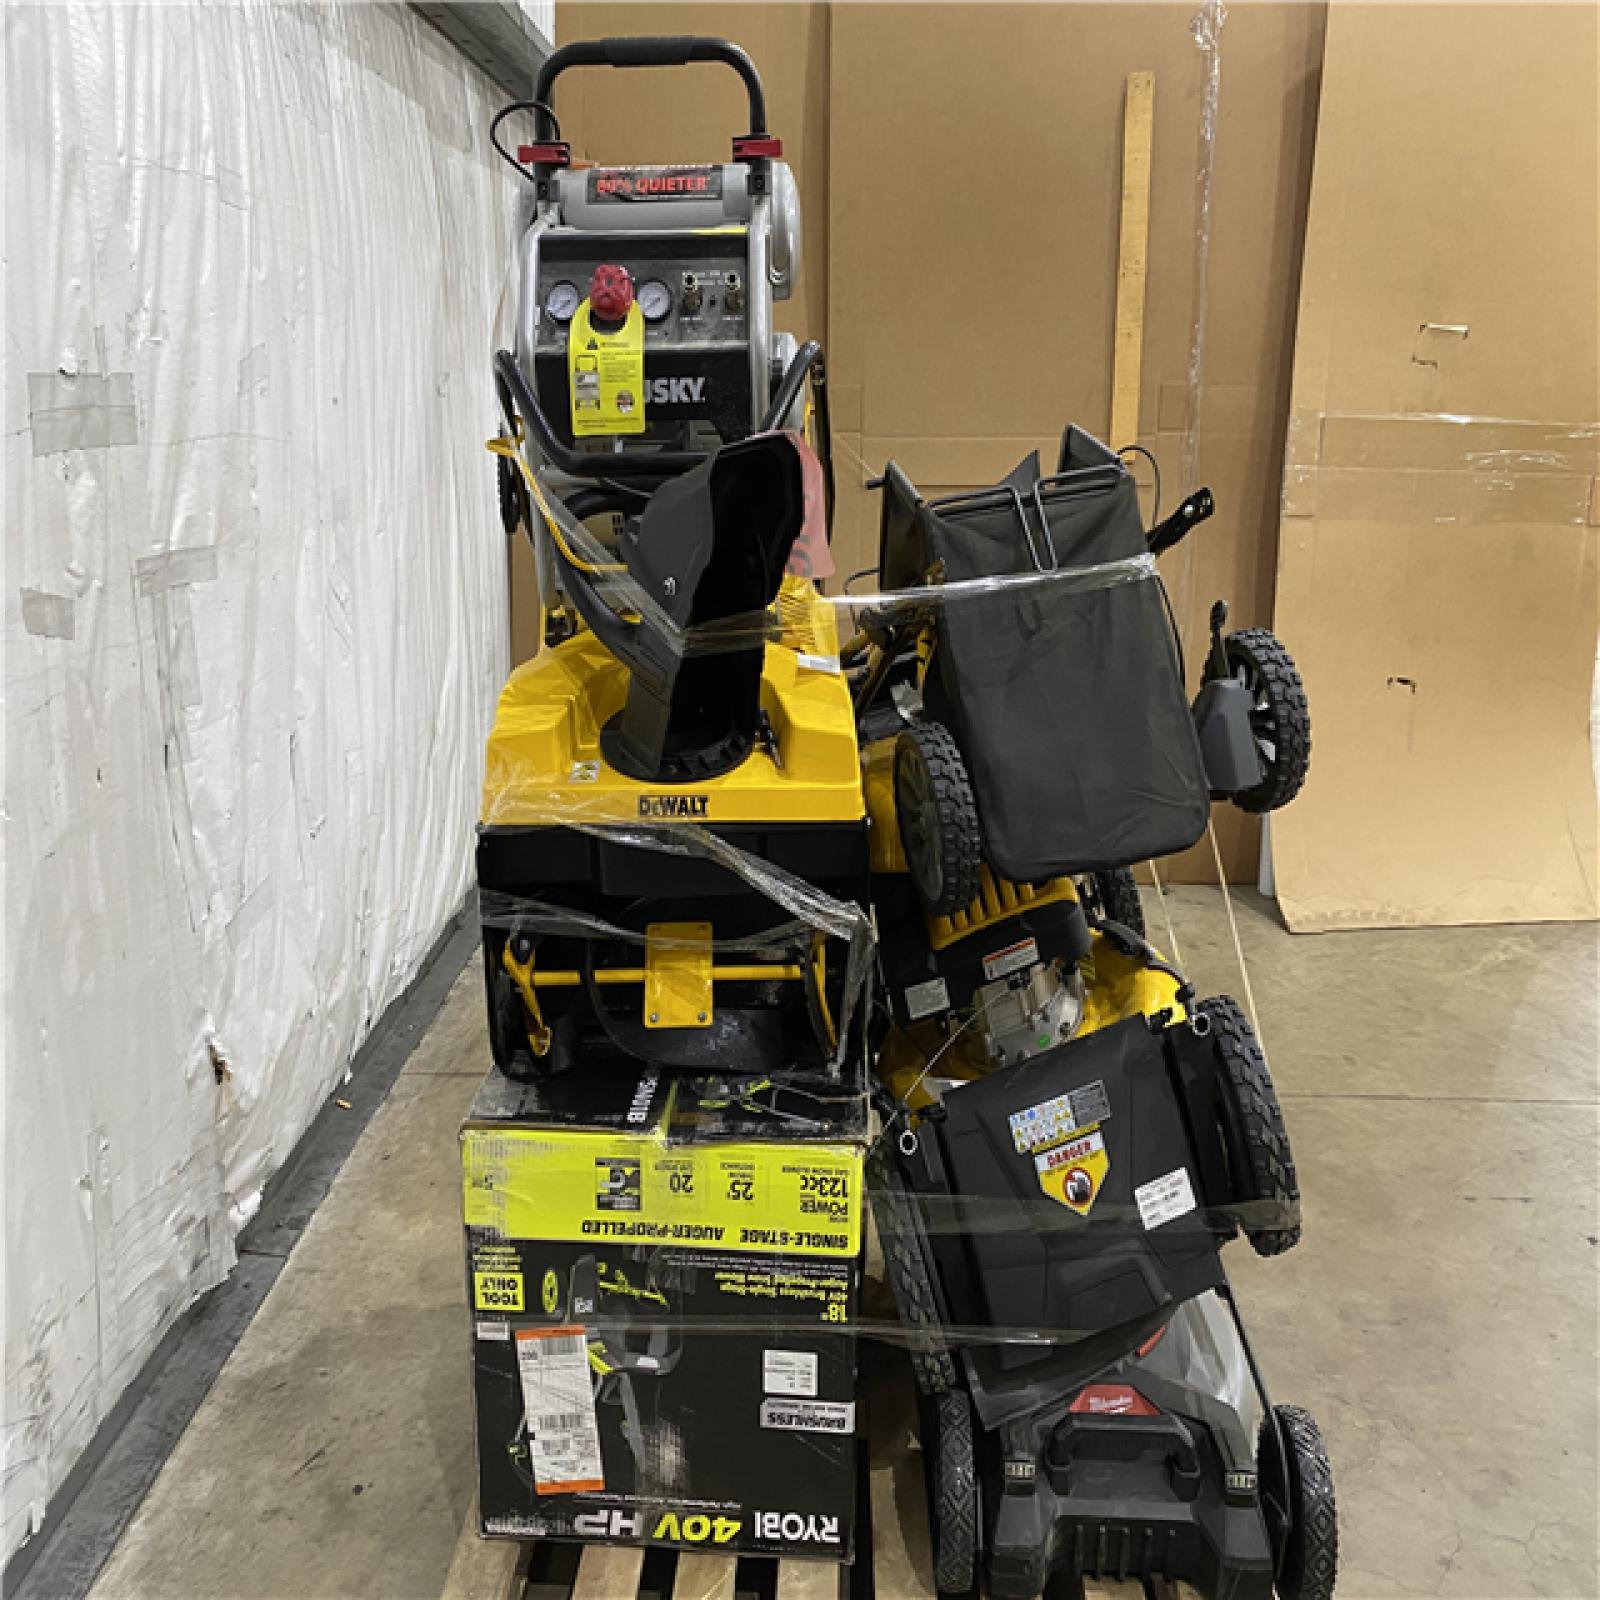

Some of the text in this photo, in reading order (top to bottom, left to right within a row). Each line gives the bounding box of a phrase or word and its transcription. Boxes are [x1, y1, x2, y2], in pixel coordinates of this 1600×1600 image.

[800, 1175, 848, 1198] 123cc
[800, 1200, 848, 1216] POWER
[582, 1220, 848, 1249] SINGLE-STAGE AUGER-PROPELLED
[480, 1277, 518, 1290] ONLY
[481, 1292, 519, 1306] TOOL
[573, 1510, 642, 1536] HP
[653, 1511, 742, 1543] 40V
[754, 1511, 840, 1543] RYOBI
